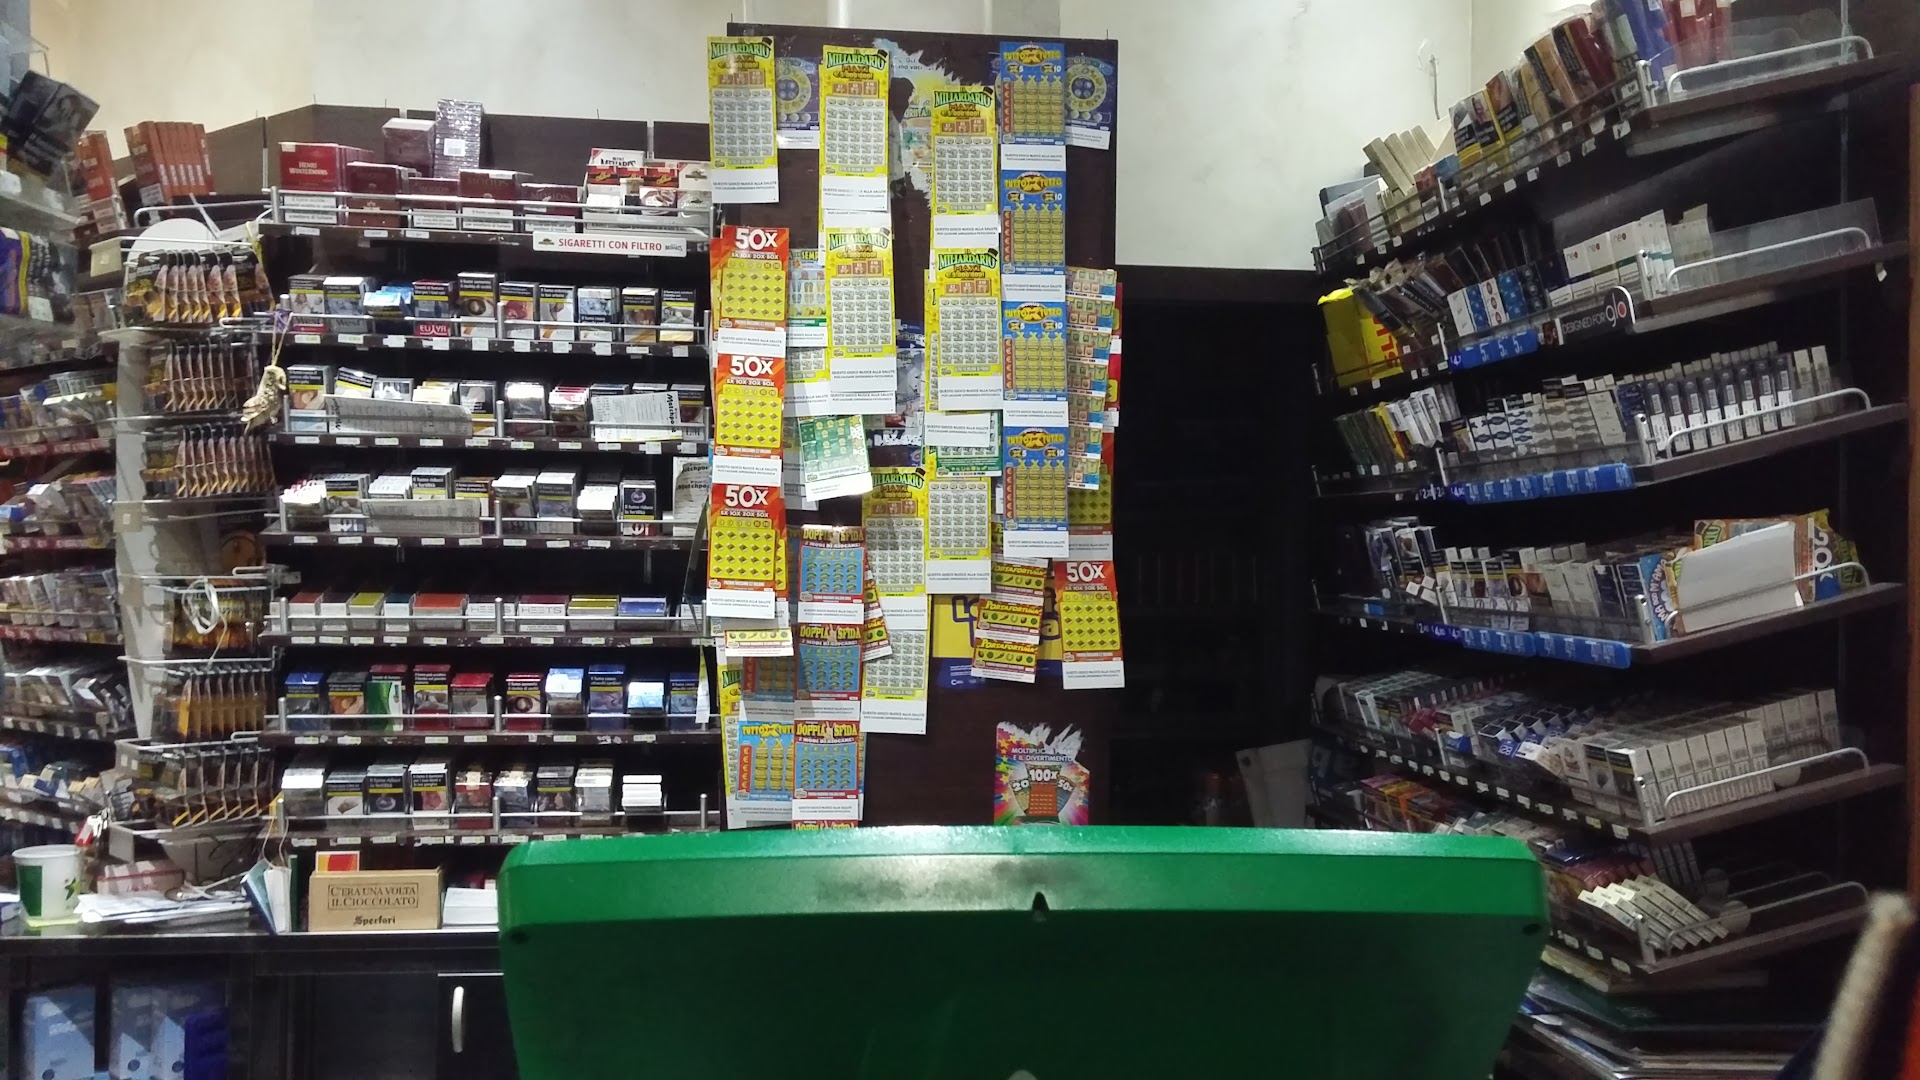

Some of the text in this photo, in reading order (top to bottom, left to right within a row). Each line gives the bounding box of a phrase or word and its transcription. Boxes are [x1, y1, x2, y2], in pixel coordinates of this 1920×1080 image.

[559, 239, 606, 248] SIGARETTI
[631, 242, 662, 250] FILTRO
[735, 228, 778, 251] 50X
[1563, 293, 1627, 334] DESIGNED FOR glo
[730, 356, 774, 377] 50X
[725, 485, 768, 508] 50X
[1066, 561, 1105, 583] 50X
[800, 626, 861, 639] DOPPIA SFIDA
[796, 724, 857, 738] DOPPIA SFIDA
[331, 886, 416, 896] C'ERA UNA VOLTA
[331, 897, 416, 906] IL CIOCCOLATO
